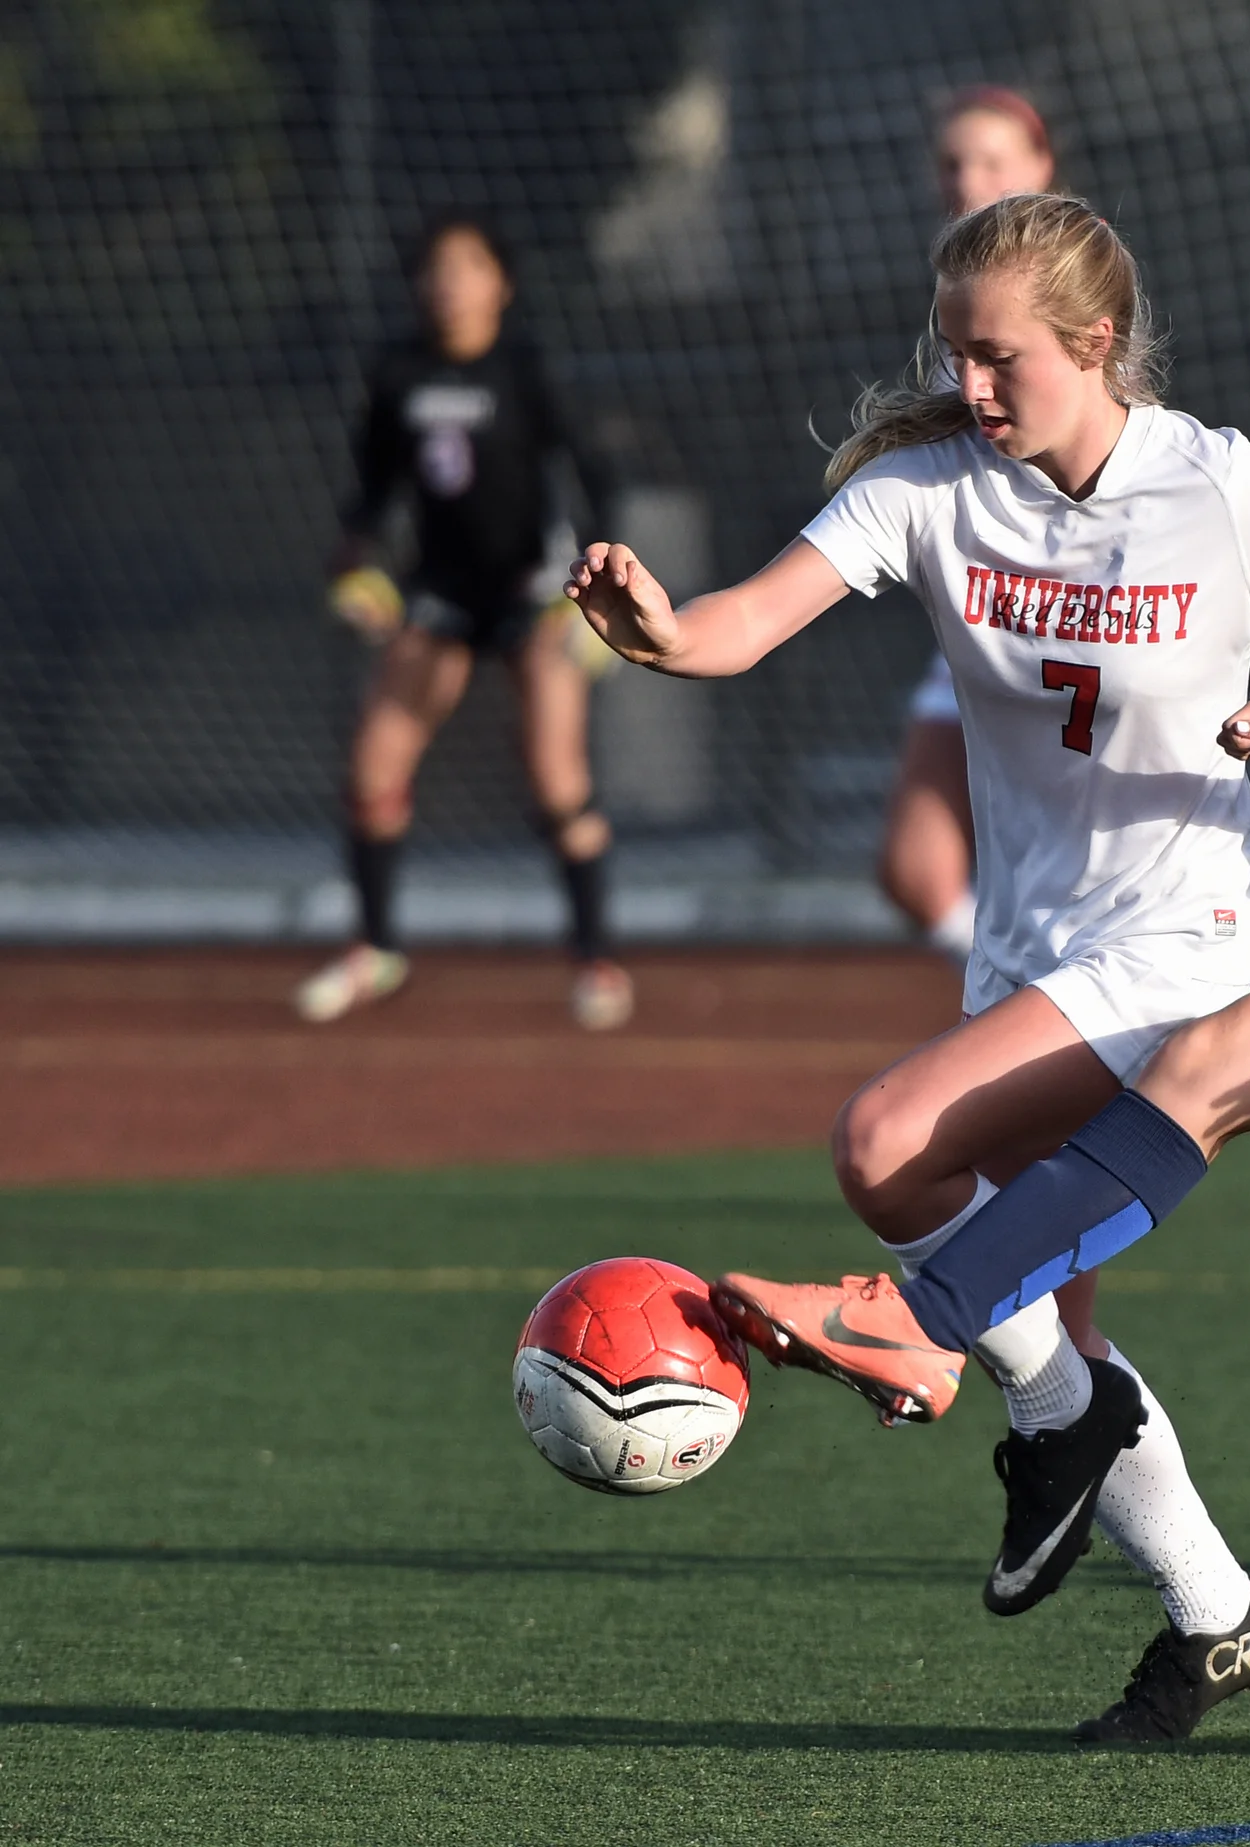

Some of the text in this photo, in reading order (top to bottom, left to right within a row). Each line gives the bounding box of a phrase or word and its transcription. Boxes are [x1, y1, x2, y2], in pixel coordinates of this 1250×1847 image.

[963, 565, 1198, 644] UNIVERSITY
[997, 592, 1157, 630] Red Devils
[1041, 658, 1101, 756] 7
[614, 1437, 630, 1475] senda
